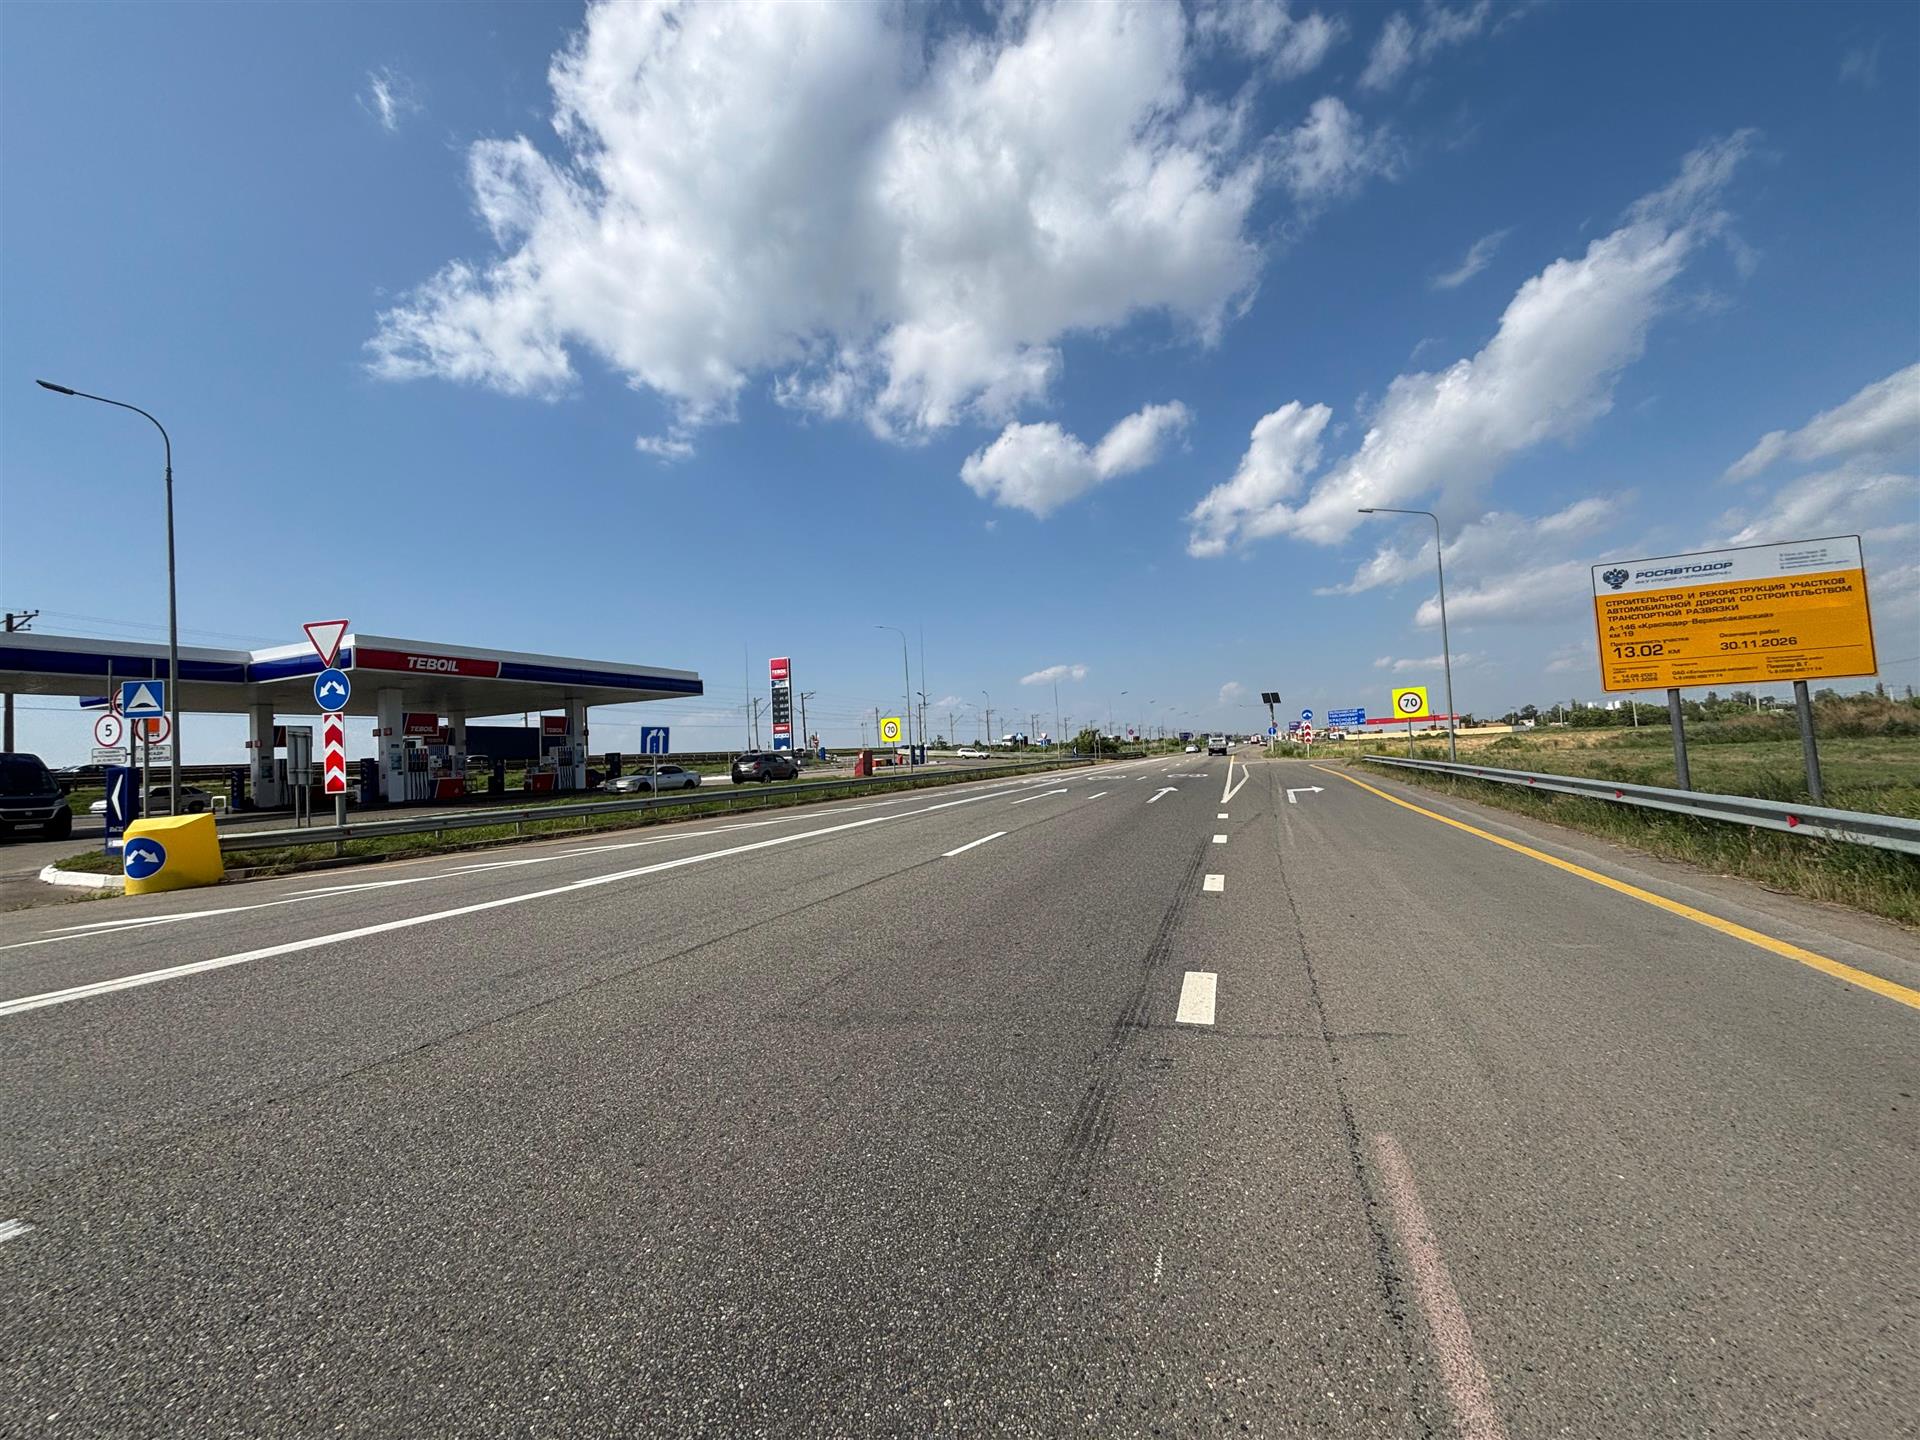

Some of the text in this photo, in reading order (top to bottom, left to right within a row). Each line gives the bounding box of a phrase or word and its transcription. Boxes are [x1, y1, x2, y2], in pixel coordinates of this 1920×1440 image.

[1635, 562, 1733, 578] РОСАВТОДОР
[1605, 594, 1684, 607] СТРОИТЕЛЬСТВО
[1699, 584, 1786, 598] РЕКОНСТРУКЦИЯ
[1790, 578, 1846, 589] УЧАСТКОВ
[1606, 600, 1691, 614] АВТОМОБИЛЬНОЙ
[1695, 597, 1736, 608] ДОРОГИ
[1755, 585, 1852, 601] СТРОИТЕЛЬСТВОМ
[1607, 604, 1739, 622] ТРАНСПОРТНОЙ РАЗВЯЗКИ
[1609, 624, 1636, 632] А-146
[1720, 636, 1798, 651] 30.11.2026
[1613, 644, 1664, 659] 13.02
[407, 656, 460, 673] TEBOIL
[1403, 697, 1418, 708] 70
[105, 724, 113, 737] 5
[887, 725, 896, 734] 70
